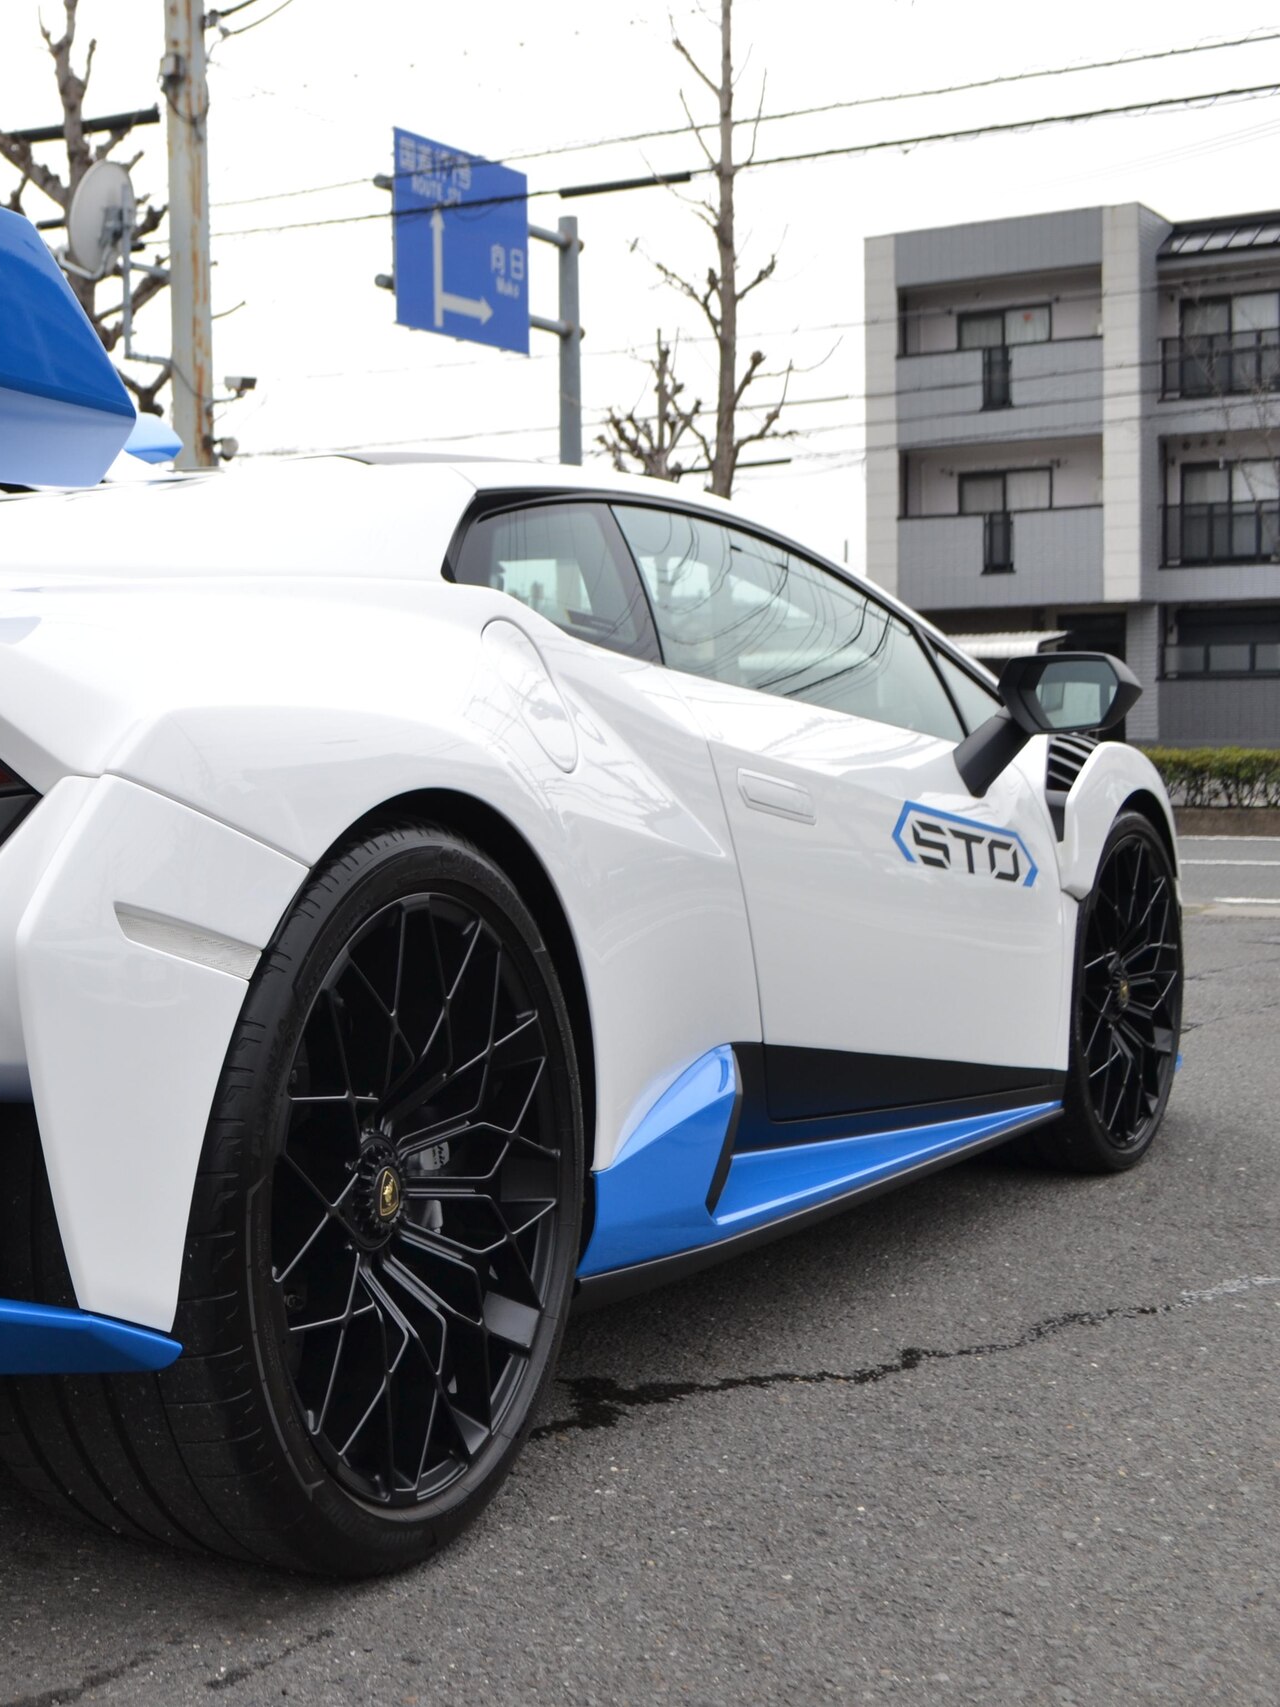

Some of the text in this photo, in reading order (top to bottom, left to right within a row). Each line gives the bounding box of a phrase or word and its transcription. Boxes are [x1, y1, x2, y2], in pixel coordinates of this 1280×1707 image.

[411, 173, 443, 202] ROUTE
[490, 242, 524, 281] 向日
[911, 819, 1020, 883] STO
